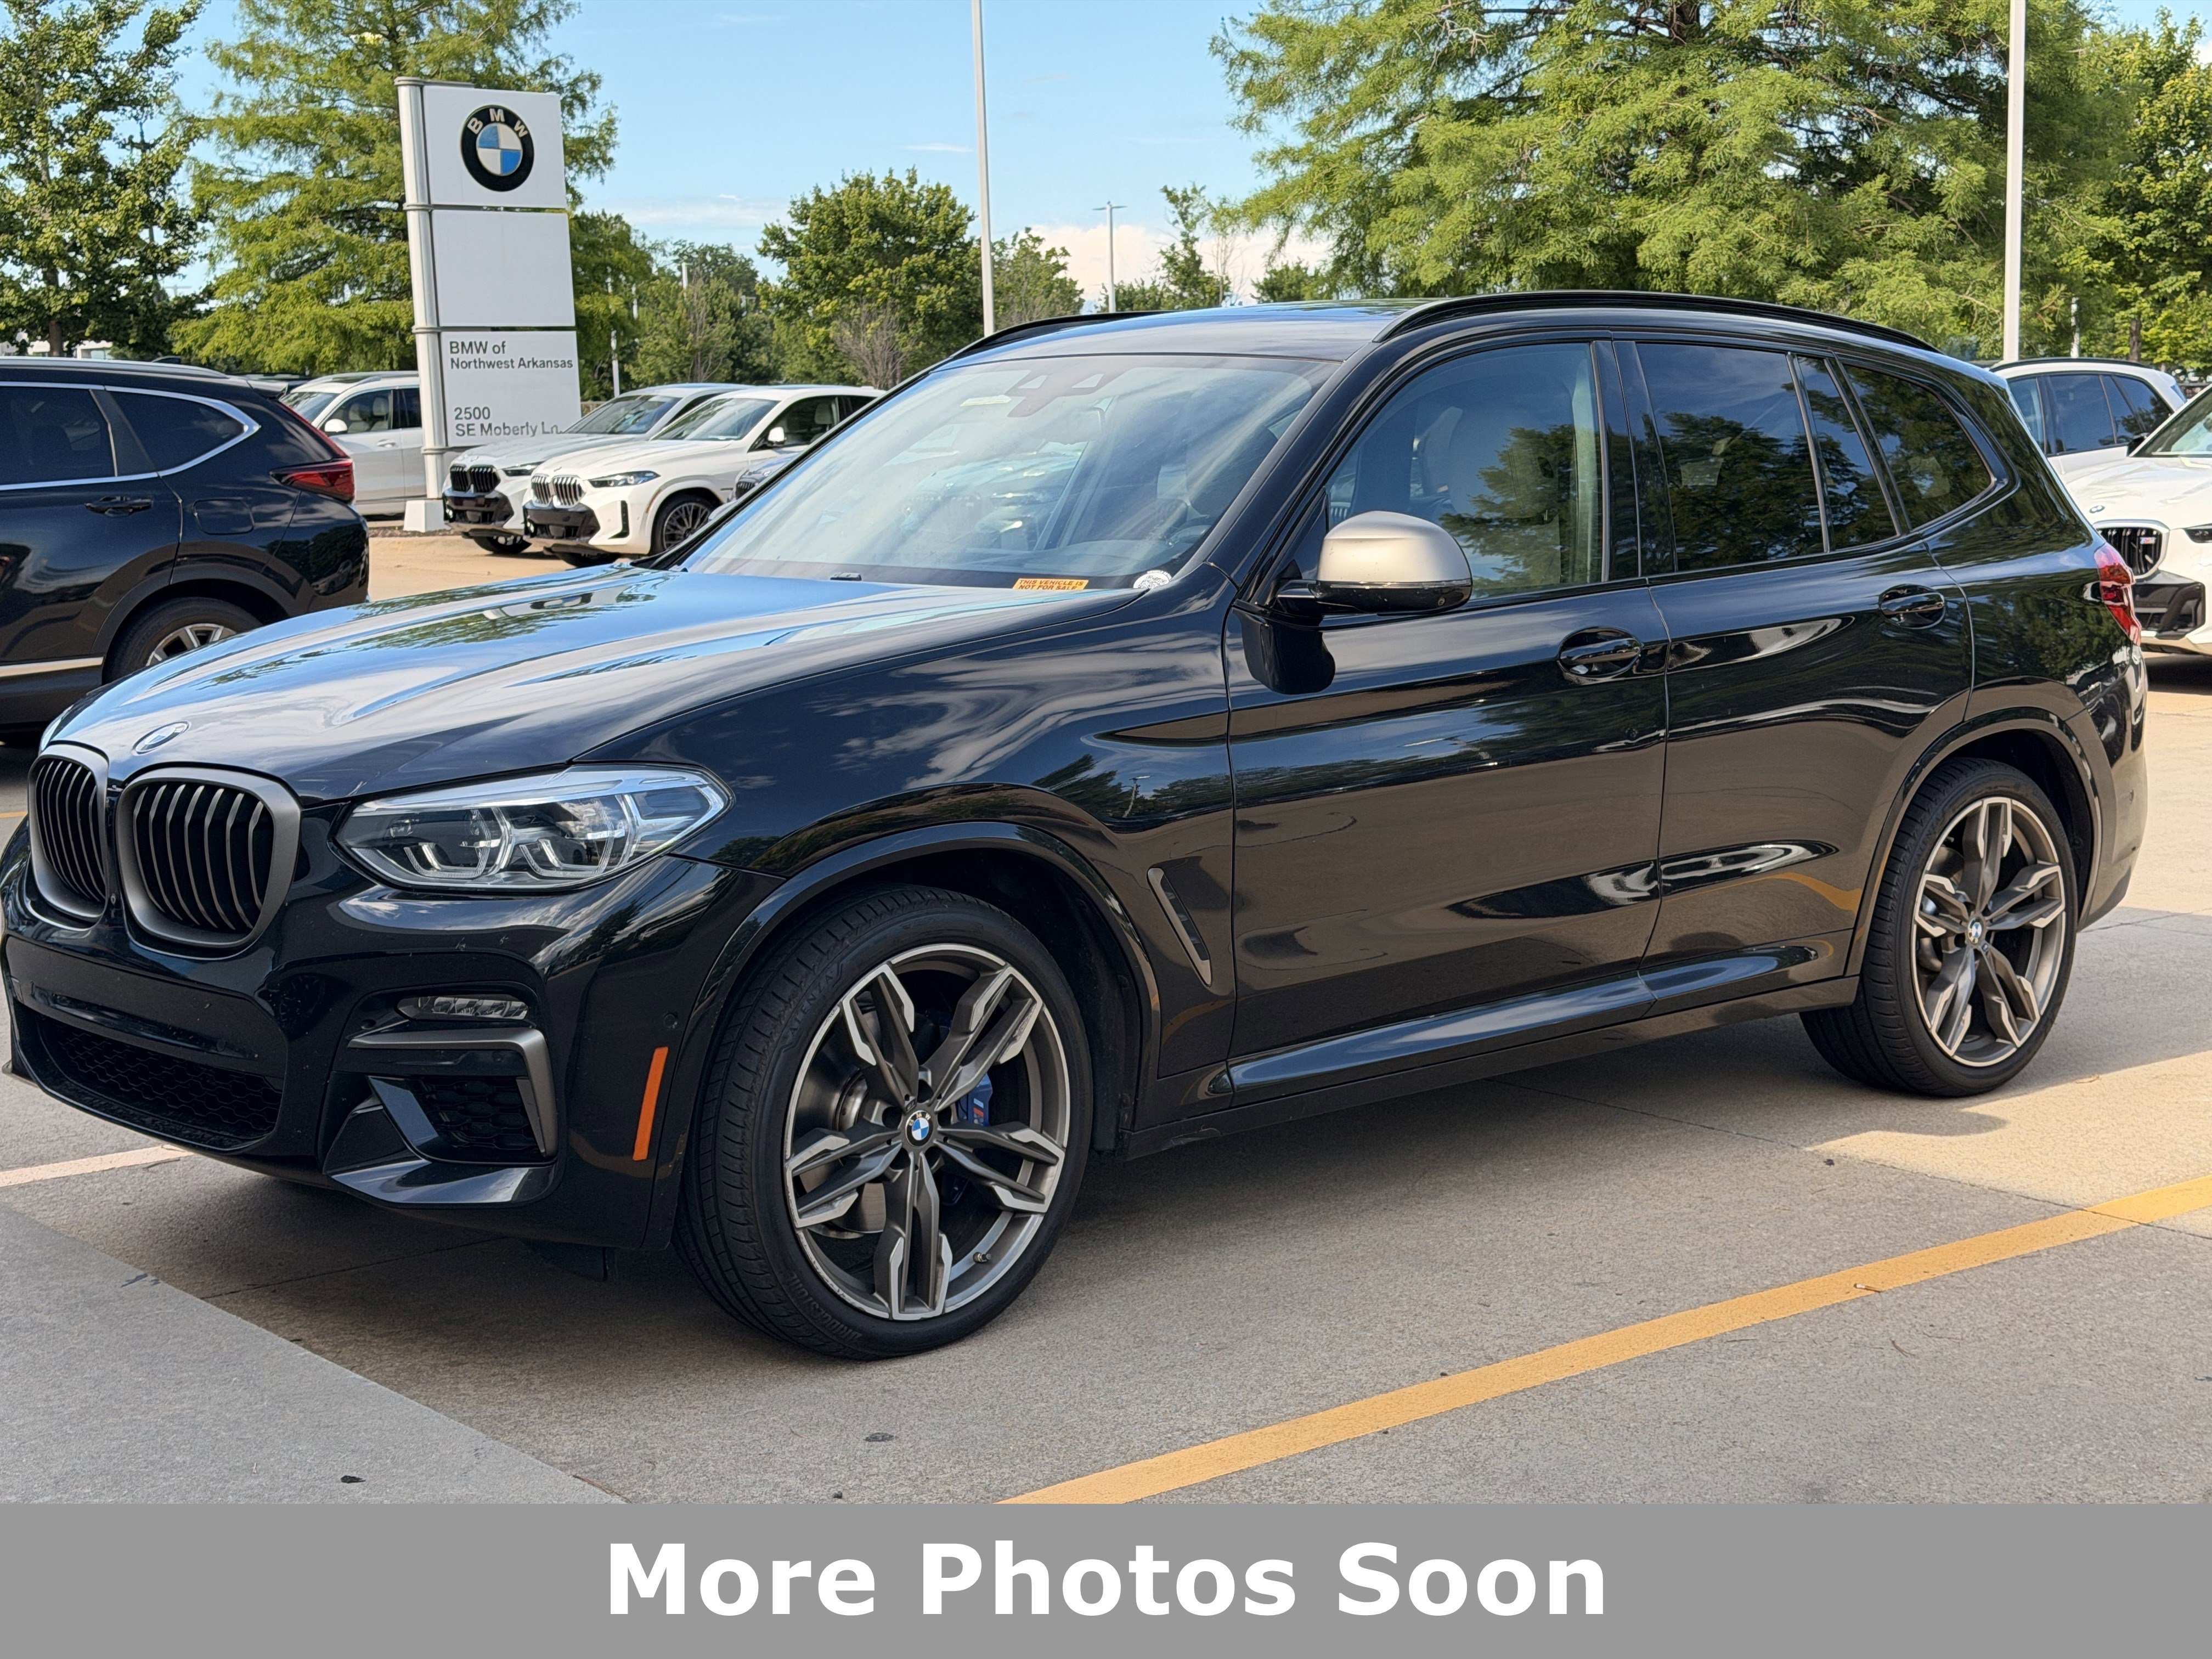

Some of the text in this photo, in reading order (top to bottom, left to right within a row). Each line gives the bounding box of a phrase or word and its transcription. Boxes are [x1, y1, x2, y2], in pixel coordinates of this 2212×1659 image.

[467, 108, 527, 137] BMW
[449, 341, 506, 354] BMW of
[450, 357, 573, 369] Northwest Arkansas
[454, 407, 490, 420] 2500
[455, 423, 476, 437] SE
[480, 421, 538, 437] Moberly
[908, 1113, 931, 1126] BMW
